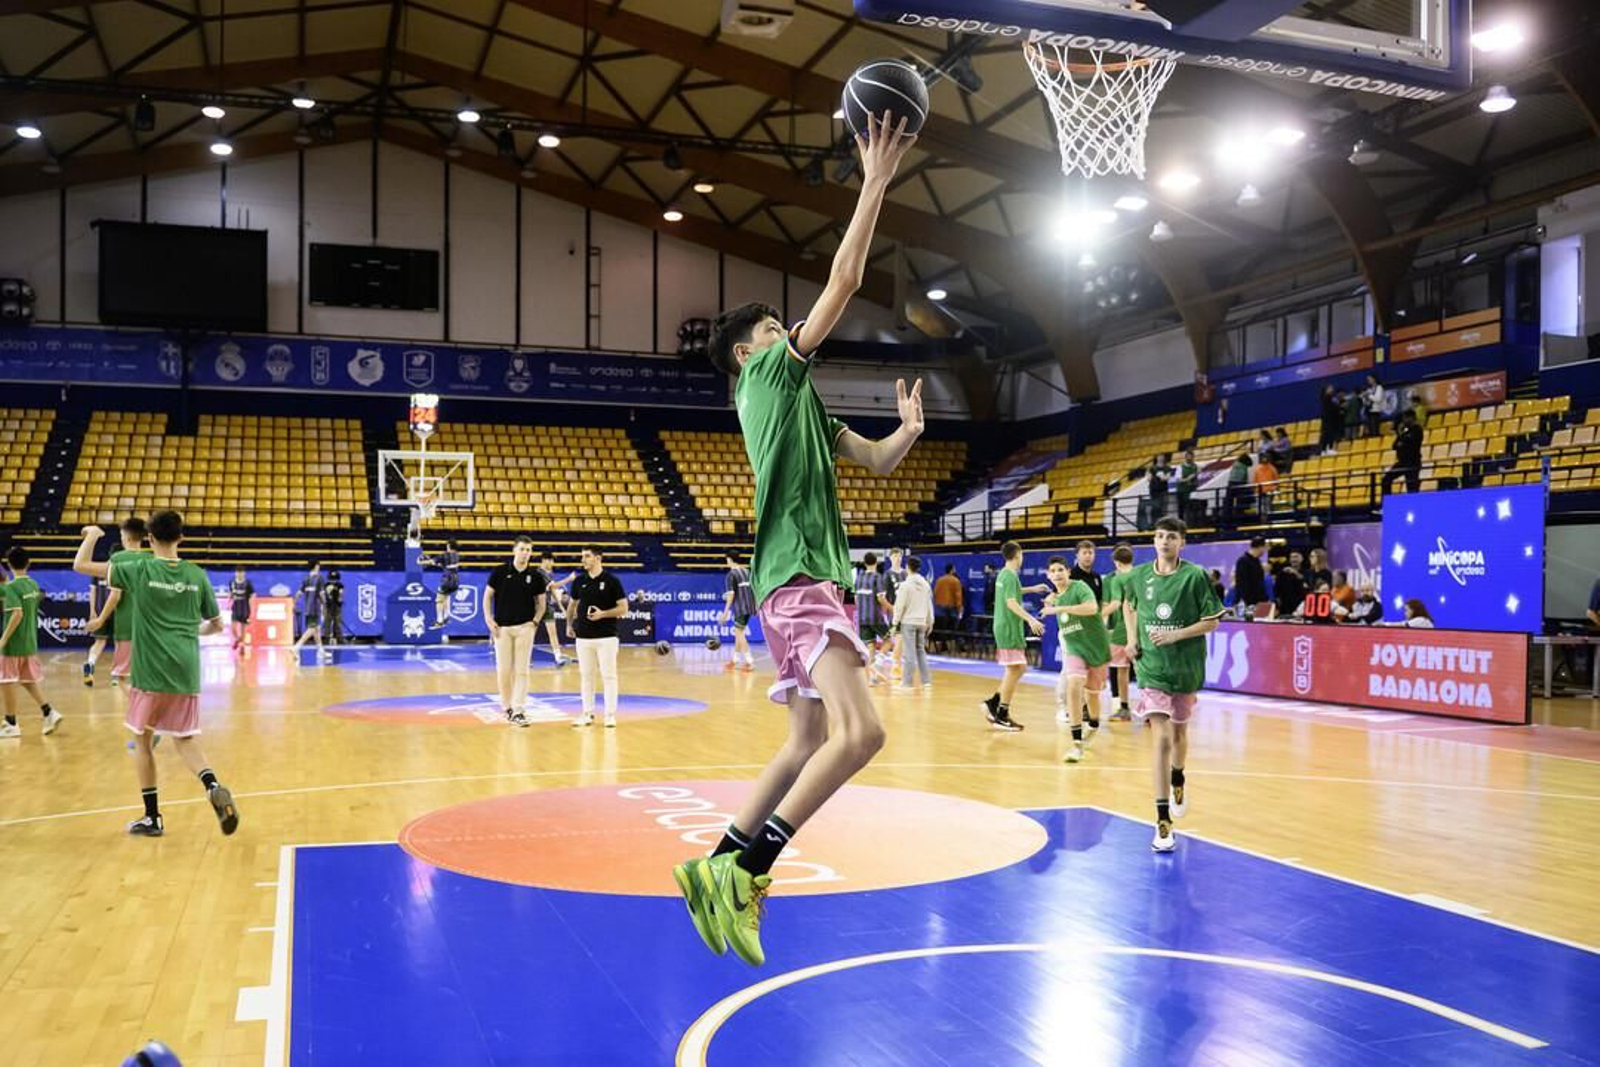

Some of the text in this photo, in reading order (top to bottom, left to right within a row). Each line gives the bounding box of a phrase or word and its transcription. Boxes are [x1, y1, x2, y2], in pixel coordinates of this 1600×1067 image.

[898, 13, 1020, 36] endesa
[1200, 54, 1307, 78] endesa
[1309, 69, 1446, 101] MINICOPA
[1304, 594, 1330, 617] 00
[673, 624, 752, 637] ANDALUCA
[1370, 643, 1493, 674] JOVENTUT
[1369, 675, 1493, 708] BADALONA
